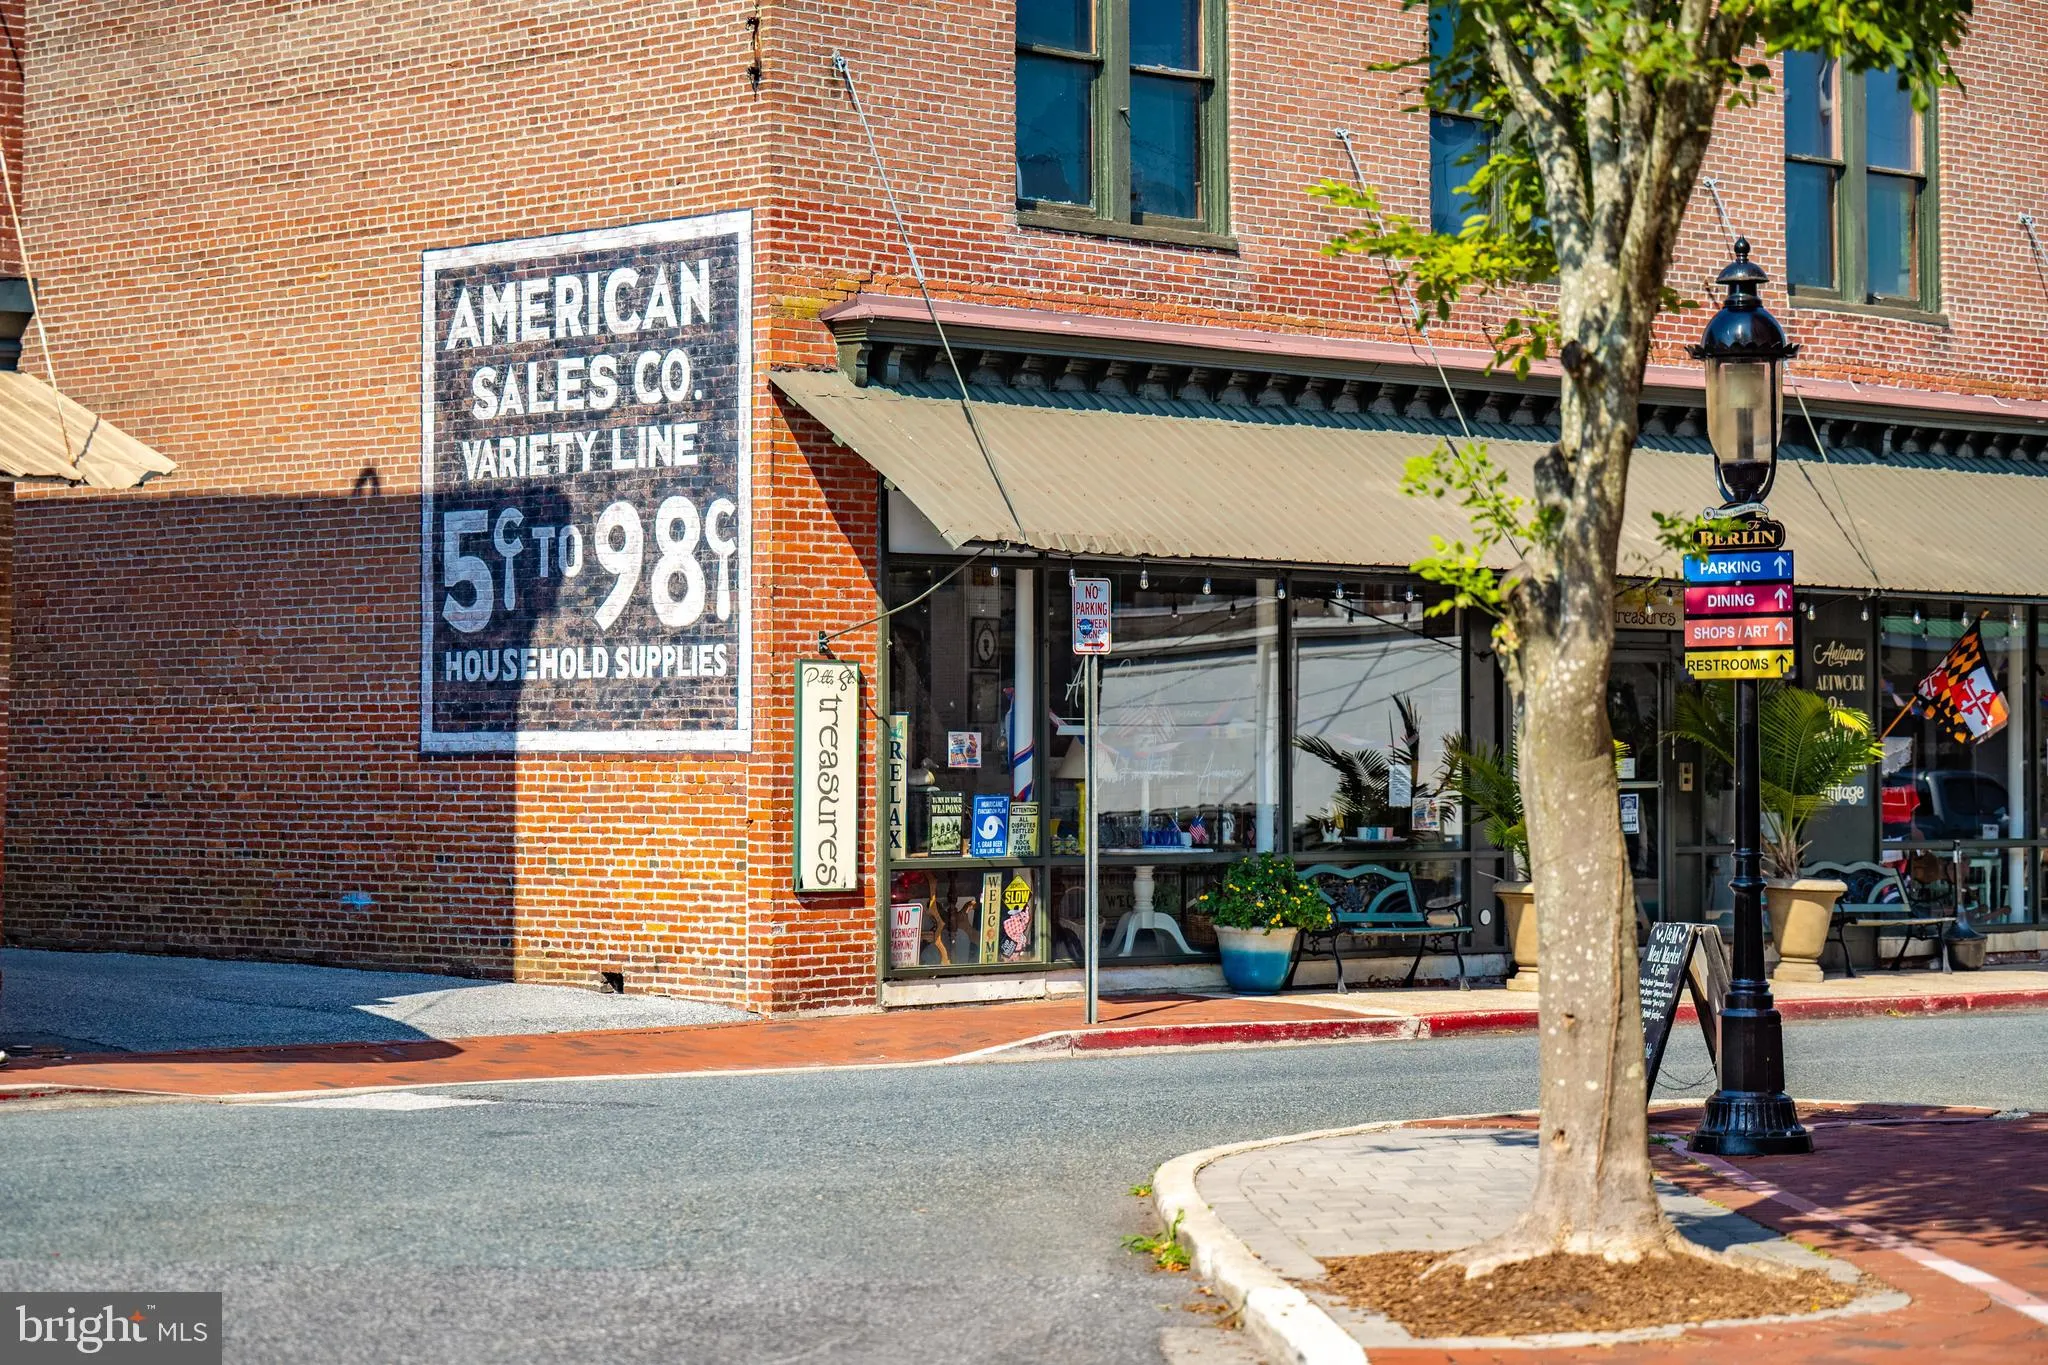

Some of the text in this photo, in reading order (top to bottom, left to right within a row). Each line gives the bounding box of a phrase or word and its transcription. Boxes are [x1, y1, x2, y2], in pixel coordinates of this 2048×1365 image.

[445, 259, 712, 350] AMERICAN
[472, 348, 703, 421] SALES CO.
[462, 423, 699, 480] VARIETY LINE
[1699, 531, 1776, 546] BERLIN
[532, 525, 583, 577] TO
[1700, 561, 1761, 575] PARKING
[1085, 585, 1098, 599] NO
[1076, 602, 1107, 615] PARKING
[1707, 594, 1755, 608] DINING
[1694, 626, 1735, 639] SHOPS
[1744, 625, 1769, 638] ART
[1813, 640, 1866, 668] Antiques
[446, 643, 727, 682] HOUSEHOLD SUPPLIES
[1687, 658, 1769, 672] RESTROOMS
[1816, 674, 1866, 691] ARTWORK
[815, 693, 843, 886] treasures
[890, 741, 902, 848] RELAX
[931, 804, 962, 814] WEAPONS
[992, 840, 1003, 848] BEER
[1005, 890, 1030, 904] SLOW
[897, 910, 910, 925] NO
[891, 927, 919, 939] VERNIGHT
[1647, 944, 1682, 965] Meat Market
